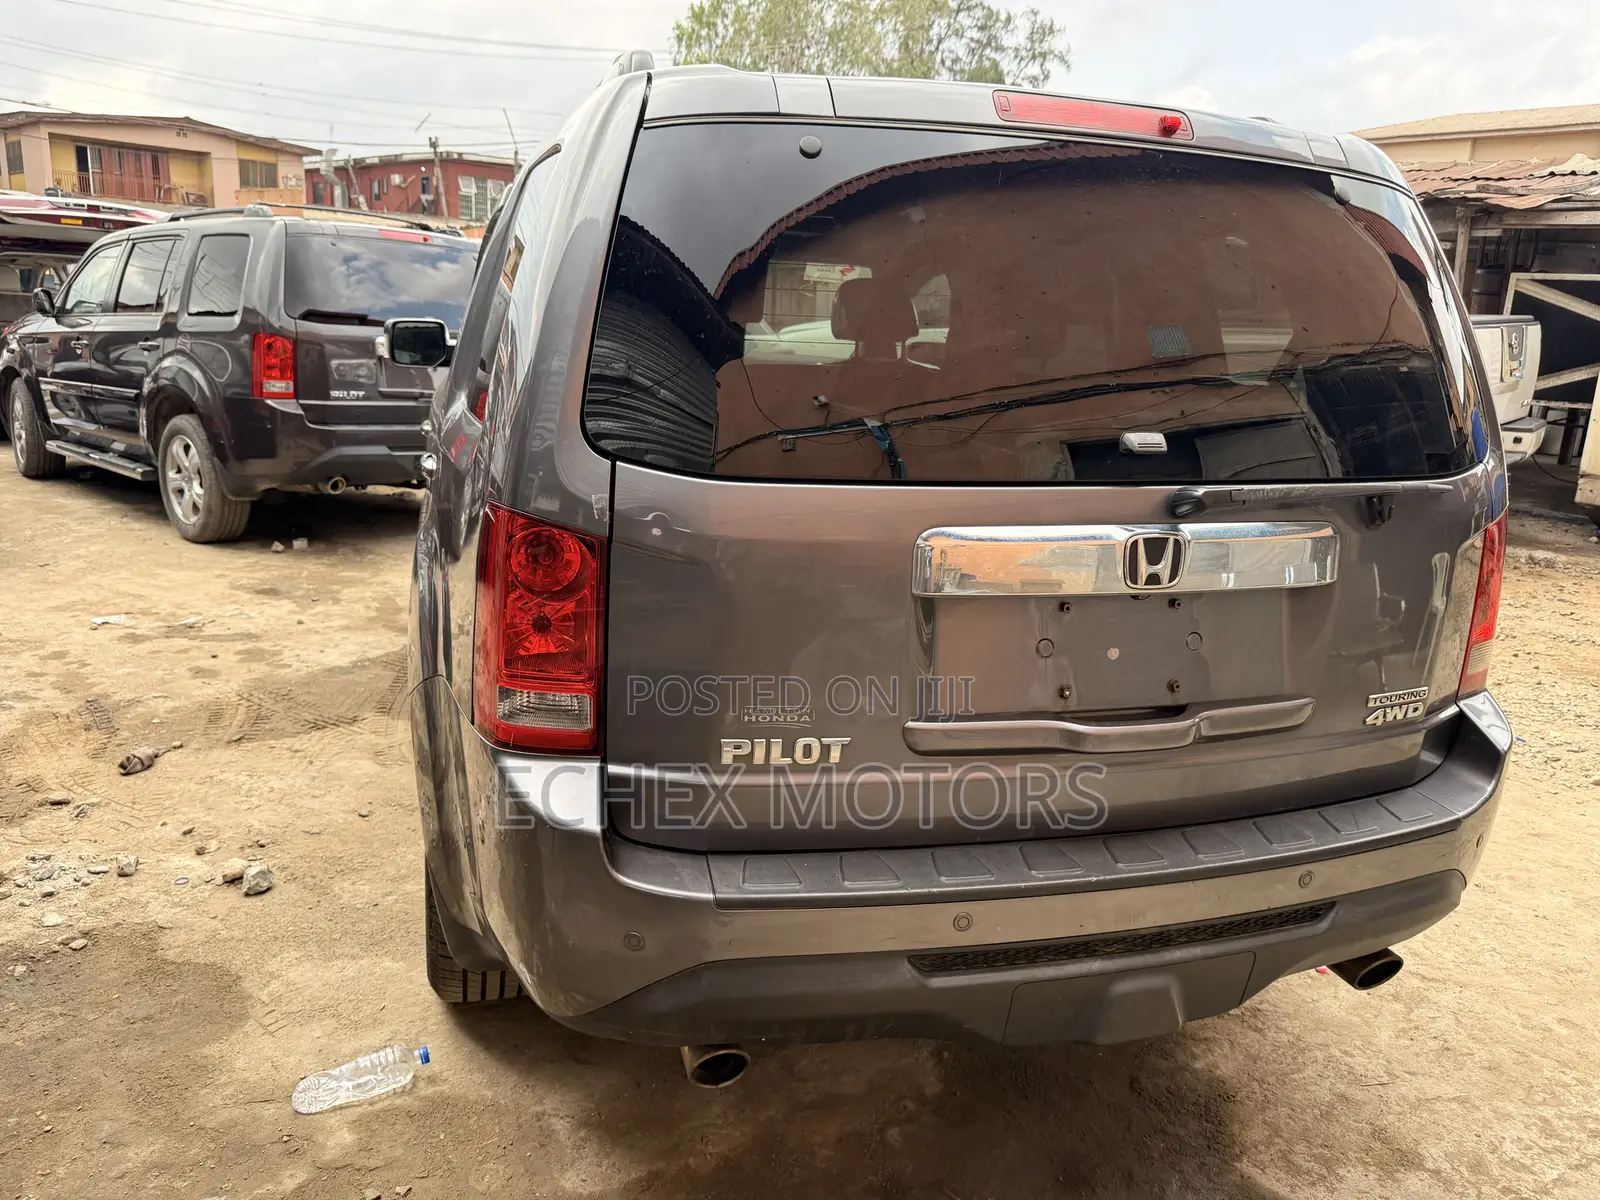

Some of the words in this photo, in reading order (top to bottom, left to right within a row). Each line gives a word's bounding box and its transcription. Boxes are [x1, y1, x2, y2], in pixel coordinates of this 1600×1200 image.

[1371, 689, 1427, 705] TOURING
[1364, 702, 1424, 726] 4WD
[720, 737, 851, 764] PILOT
